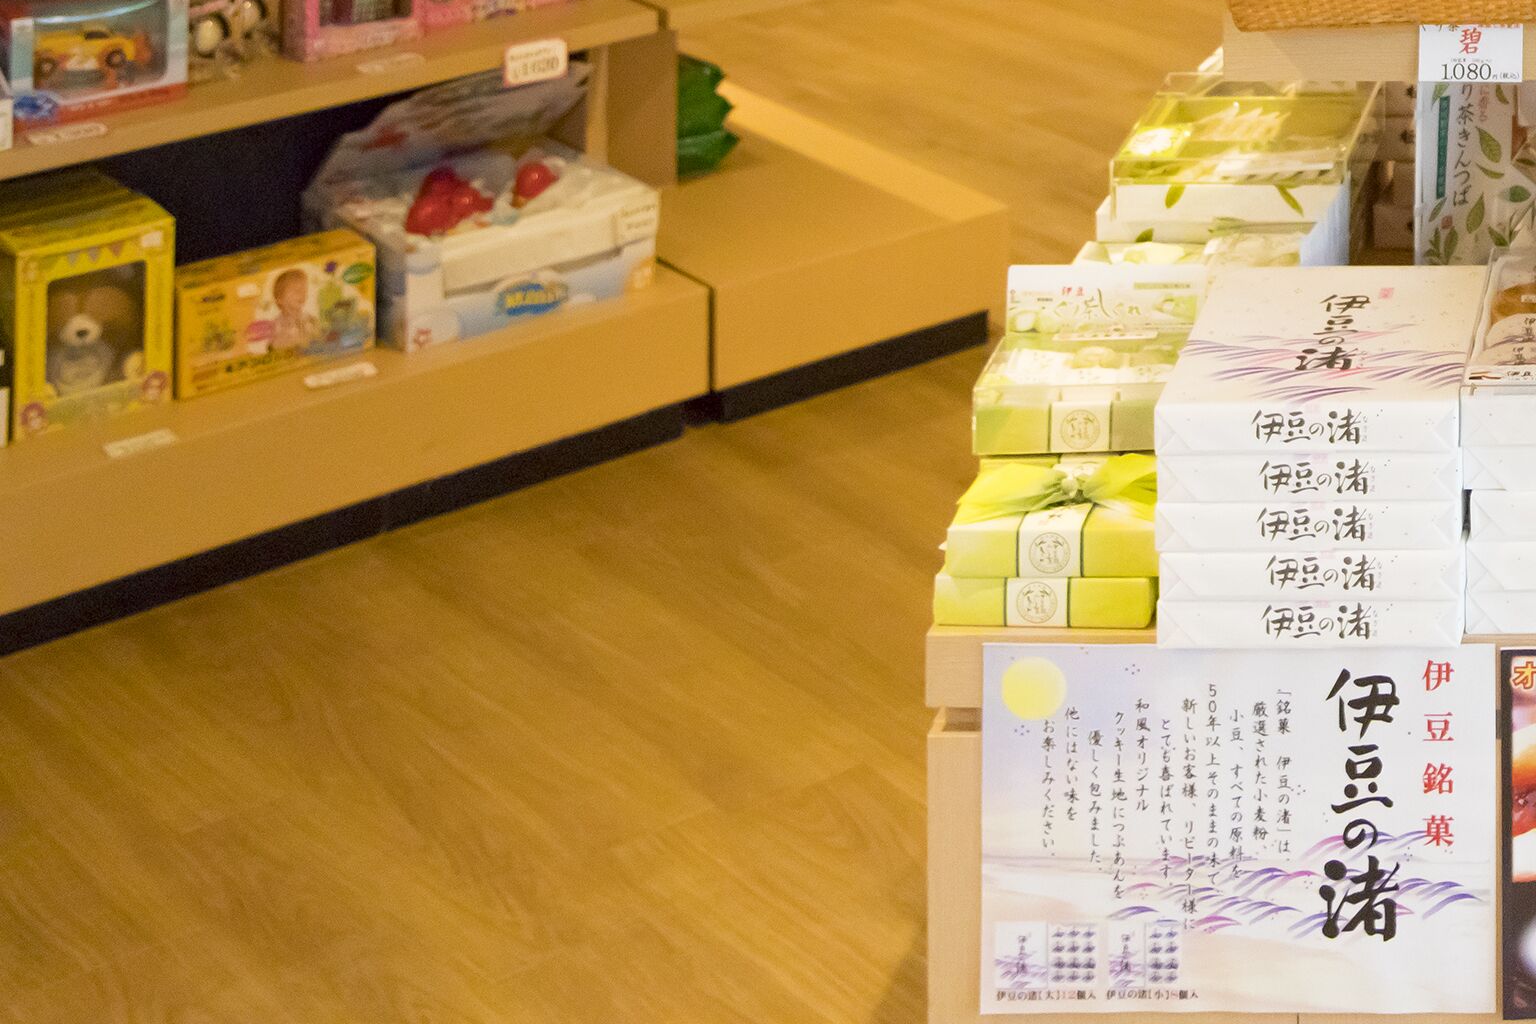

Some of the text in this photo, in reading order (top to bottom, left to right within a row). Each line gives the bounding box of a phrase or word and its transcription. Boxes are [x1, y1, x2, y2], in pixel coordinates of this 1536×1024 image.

[1459, 27, 1483, 55] 碧
[1295, 294, 1371, 371] 伊豆の渚
[1252, 409, 1360, 444] 伊豆の渚
[1257, 506, 1365, 541] 伊豆の渚
[1260, 459, 1368, 494] 伊豆の渚
[1267, 555, 1374, 591] 伊豆の渚
[1263, 603, 1370, 639] 伊豆の渚
[1041, 719, 1056, 856] お楽しみください。
[1063, 707, 1080, 821] 他にはない味を
[1088, 729, 1104, 871] 優しく包みました。
[1135, 698, 1151, 812] 和風オリジナル
[1422, 659, 1455, 846] 伊豆銘菓
[1111, 712, 1128, 899] クッキー生地につぶあんを
[1318, 668, 1400, 942] 伊豆の渚
